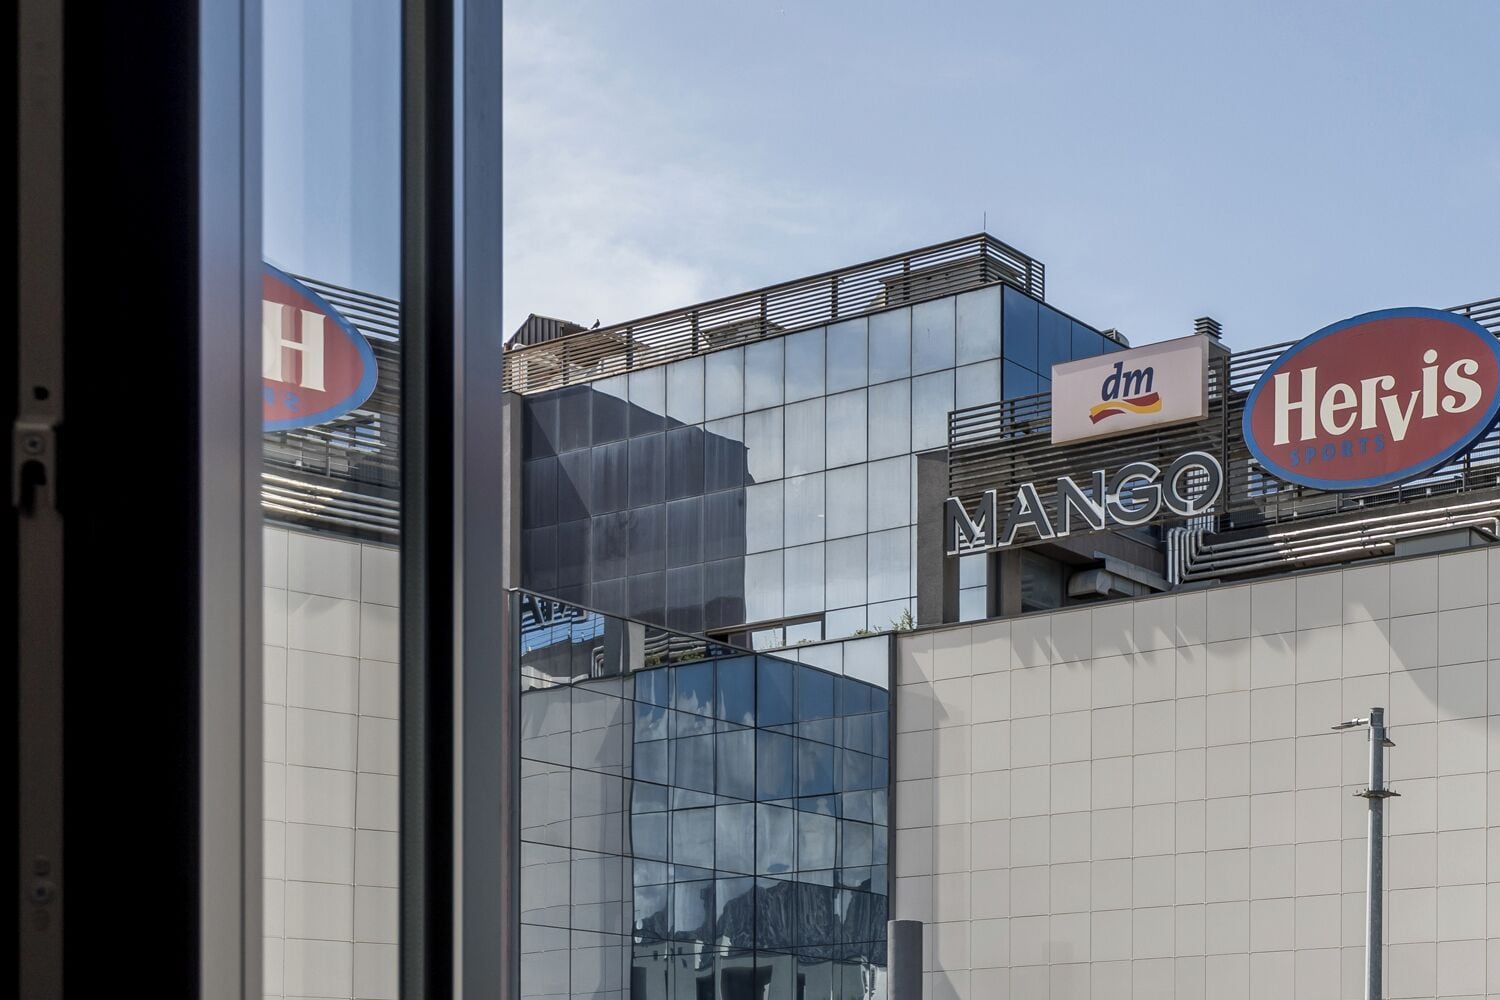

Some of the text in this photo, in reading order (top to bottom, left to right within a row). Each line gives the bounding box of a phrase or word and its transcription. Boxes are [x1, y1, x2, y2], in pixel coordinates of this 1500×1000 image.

[1101, 361, 1154, 402] dm
[1273, 349, 1483, 446] Hervis
[1289, 434, 1386, 467] SPORTS
[944, 451, 1223, 556] MANGO
